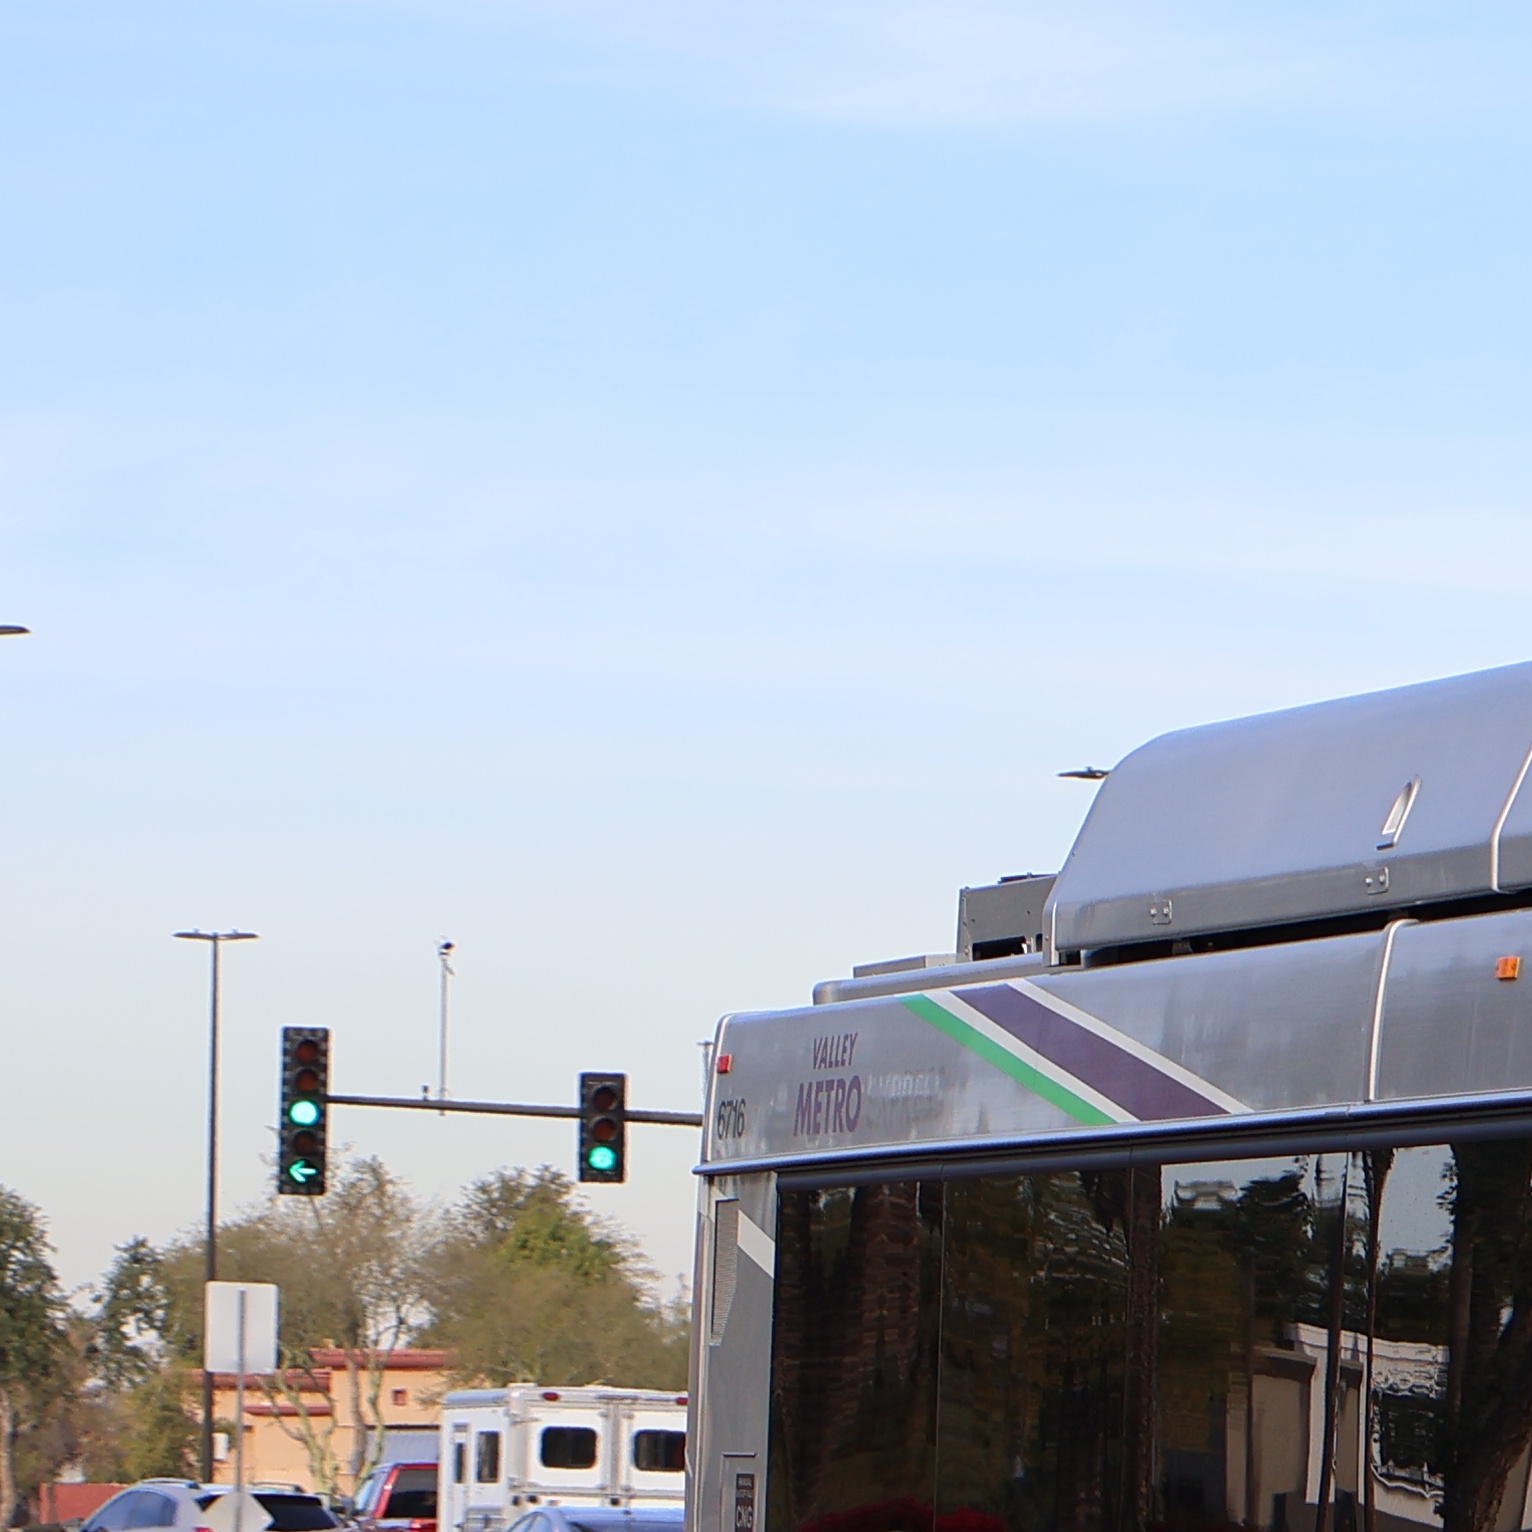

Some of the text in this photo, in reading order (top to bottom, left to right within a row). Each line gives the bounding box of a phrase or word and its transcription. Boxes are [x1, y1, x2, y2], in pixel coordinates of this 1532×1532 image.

[813, 1032, 859, 1070] VALLEY
[717, 1098, 746, 1140] 6716
[793, 1075, 862, 1137] METRO
